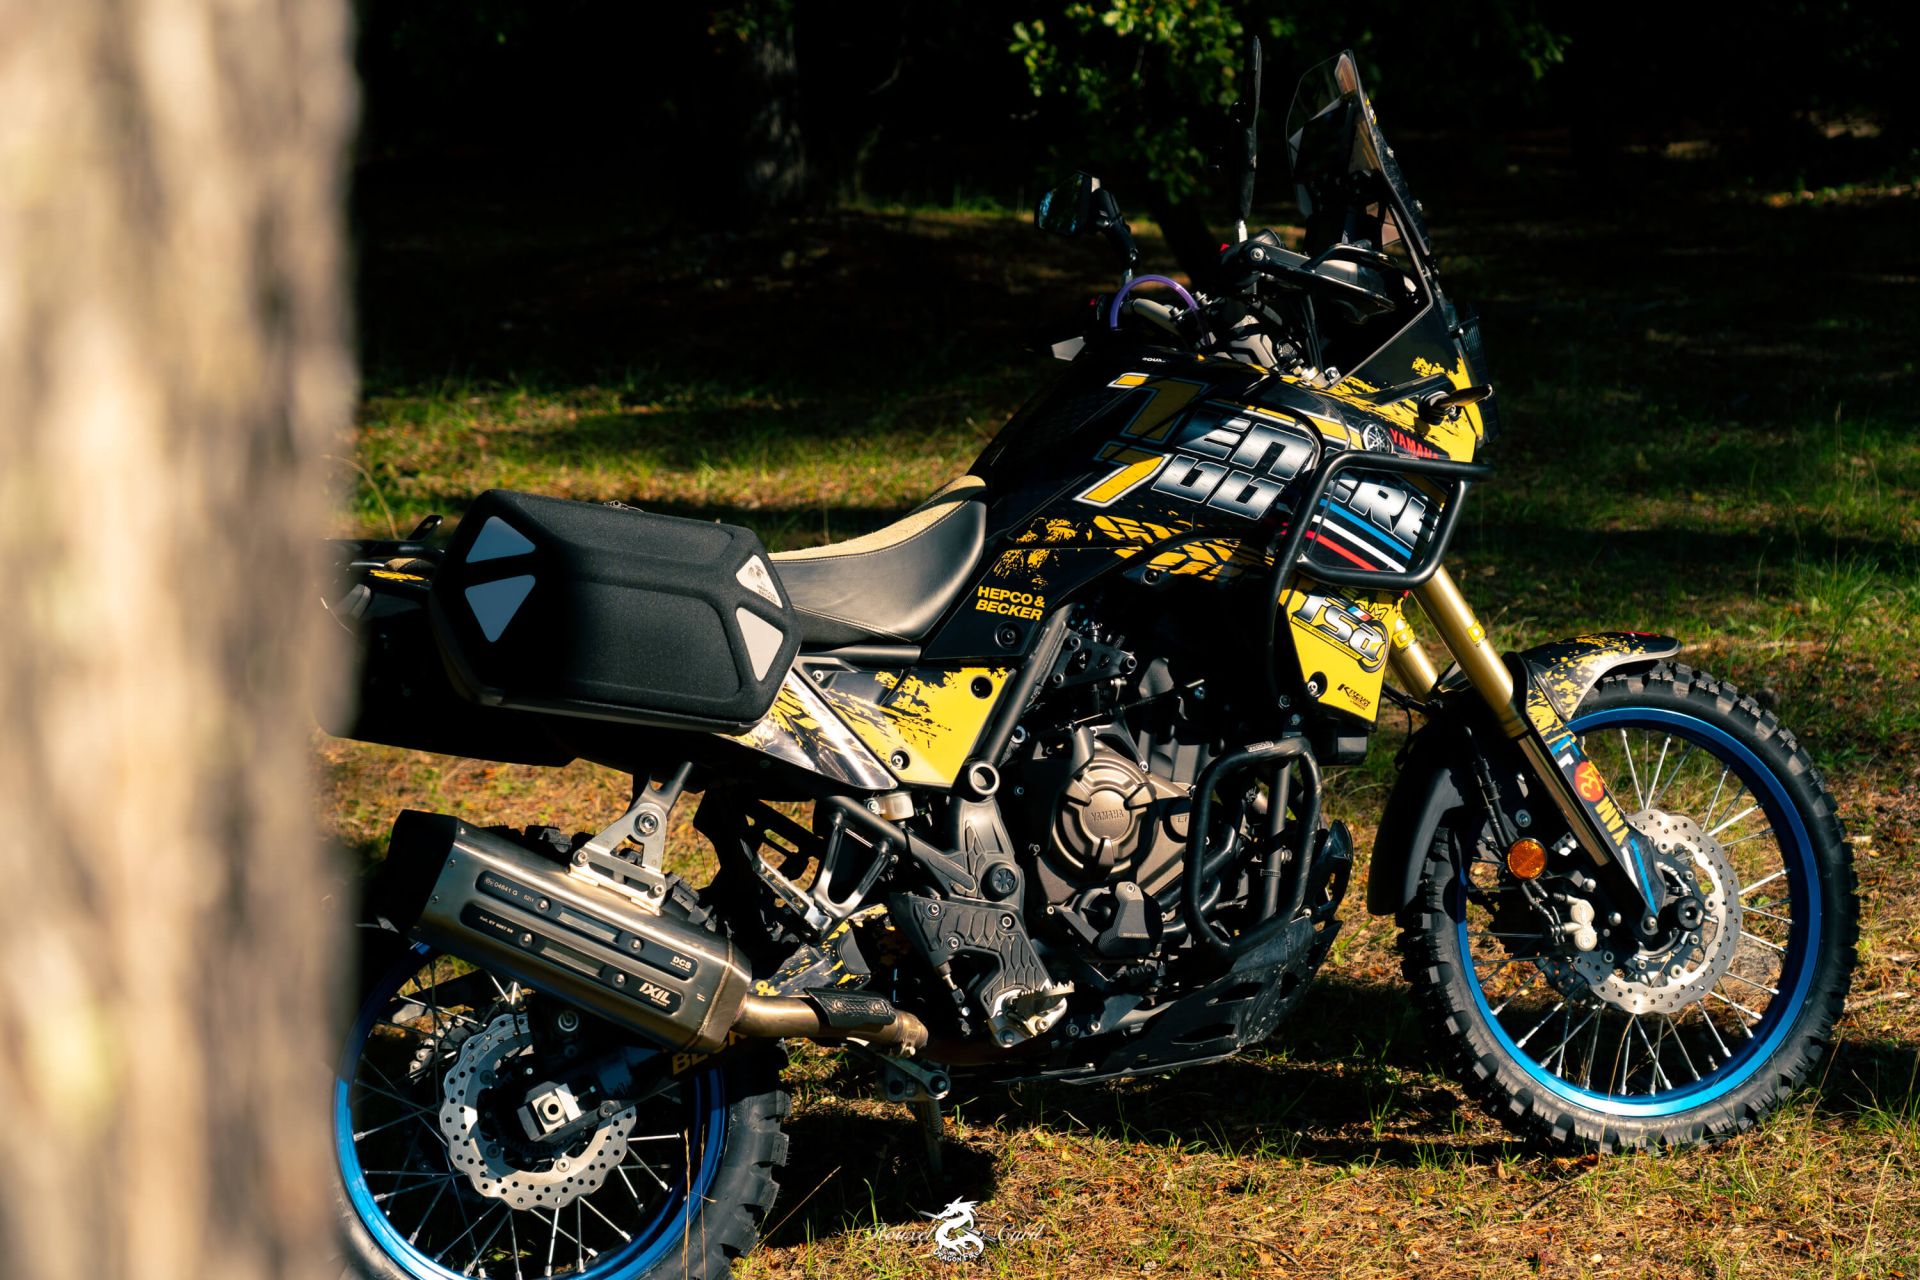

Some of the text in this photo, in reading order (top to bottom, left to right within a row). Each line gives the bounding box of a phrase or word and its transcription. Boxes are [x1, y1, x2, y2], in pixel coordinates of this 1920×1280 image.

[977, 585, 1045, 608] HEPCO &
[975, 599, 1043, 621] BECKER
[1090, 808, 1125, 822] YAMAHA
[672, 955, 692, 969] DCS
[639, 982, 671, 1005] IXIL
